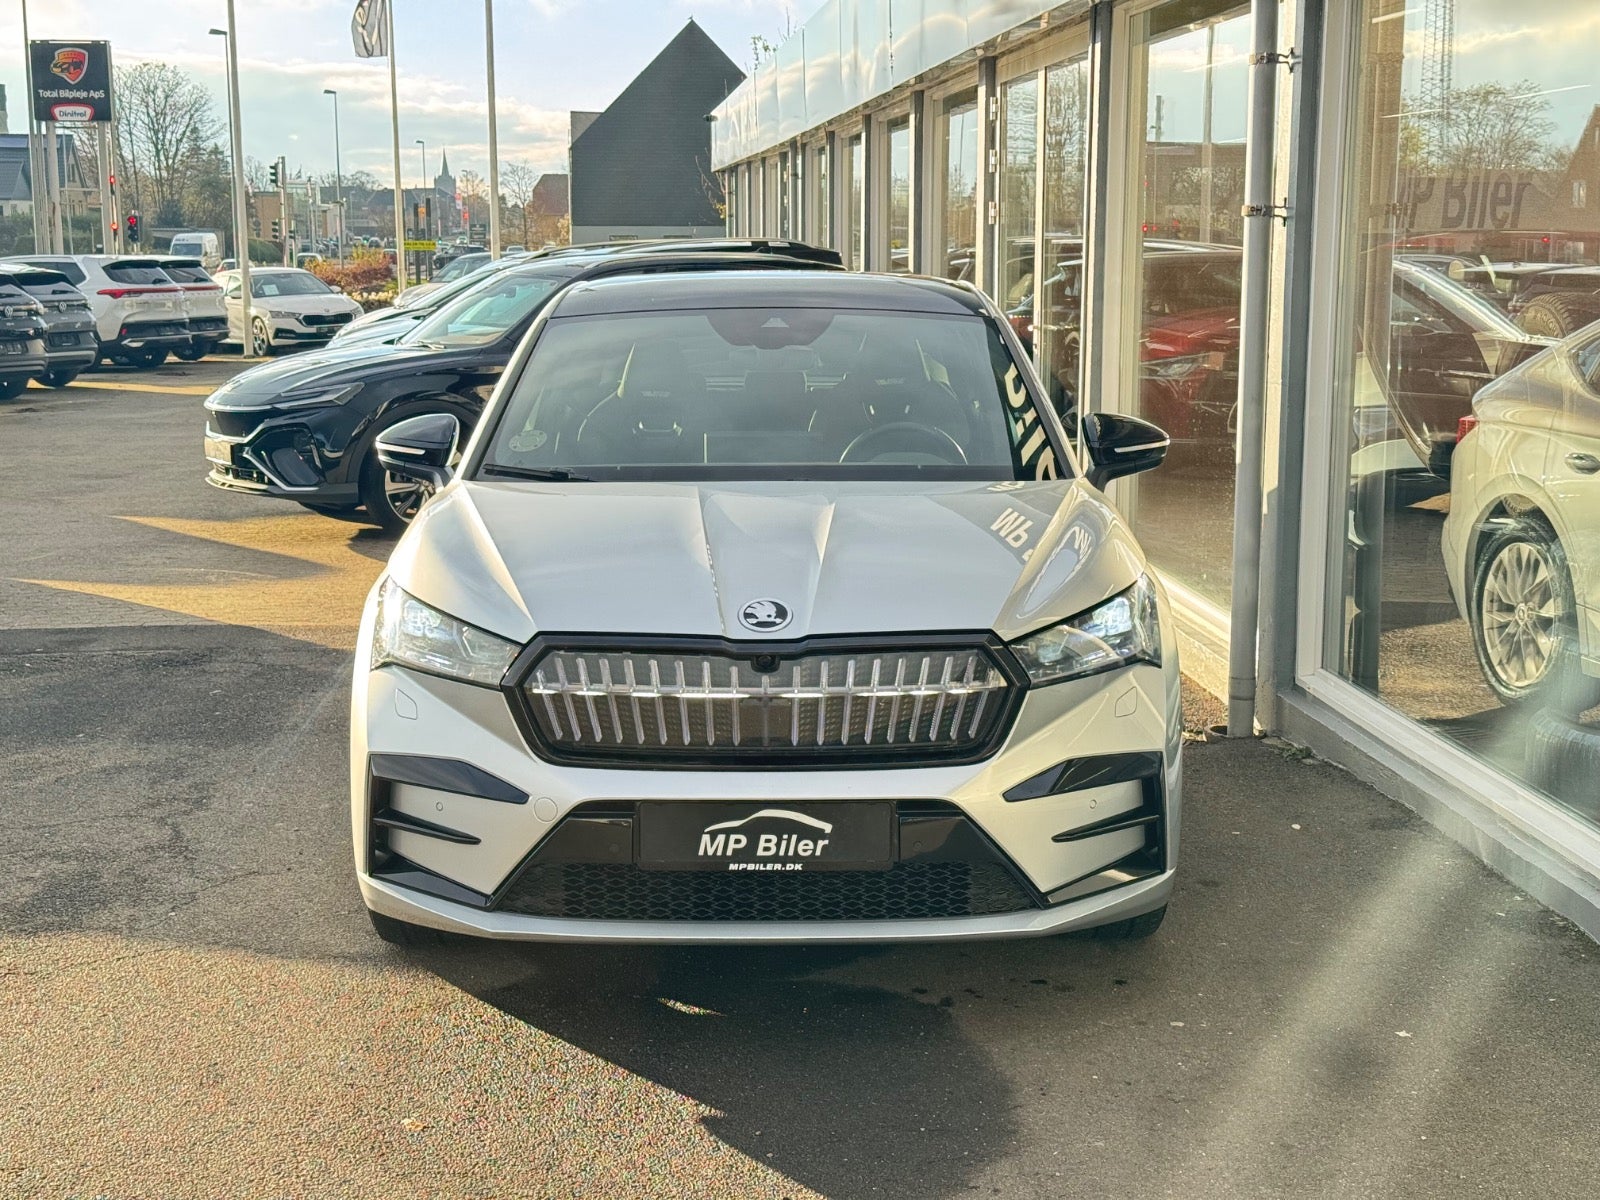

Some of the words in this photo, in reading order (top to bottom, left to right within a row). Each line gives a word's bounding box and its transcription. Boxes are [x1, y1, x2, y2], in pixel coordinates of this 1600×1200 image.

[38, 89, 58, 98] Total
[59, 89, 88, 99] Bilpleje
[89, 90, 105, 99] ApS
[698, 834, 747, 856] MP
[756, 834, 829, 856] Biler
[729, 863, 803, 871] MPBILER.DK
